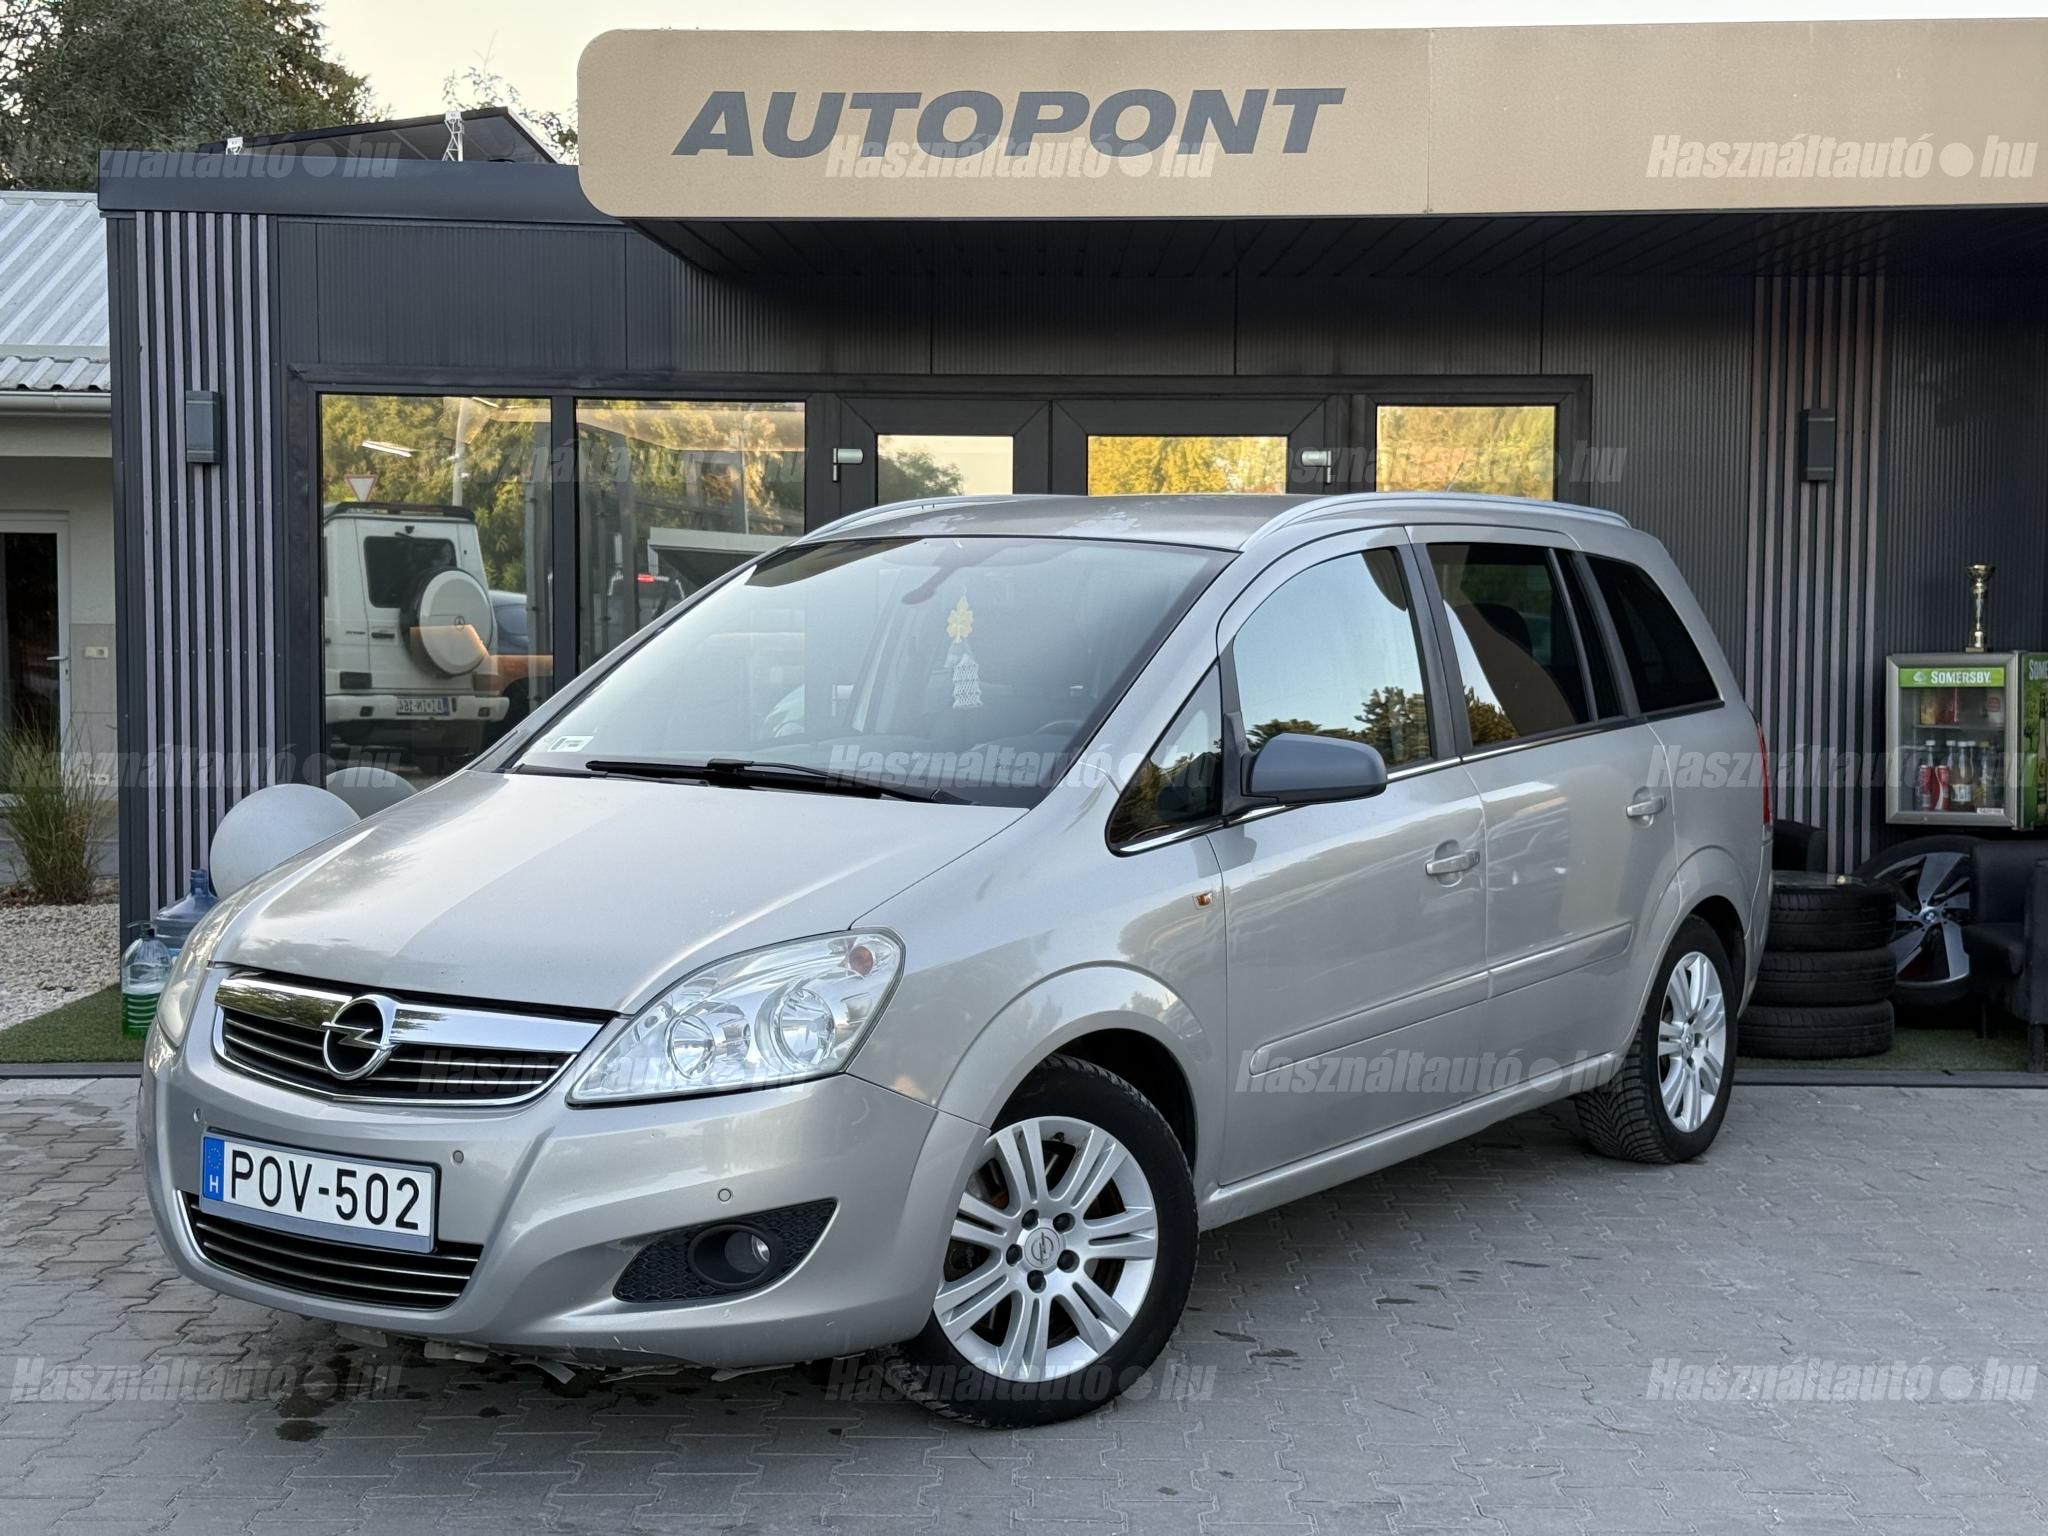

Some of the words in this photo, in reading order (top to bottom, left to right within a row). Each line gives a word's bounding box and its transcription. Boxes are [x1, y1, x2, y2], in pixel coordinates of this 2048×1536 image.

[672, 88, 1344, 158] AUTOPONT
[1931, 671, 1992, 684] SOMERSBY
[209, 1175, 219, 1194] H
[231, 1149, 420, 1230] POV-502
